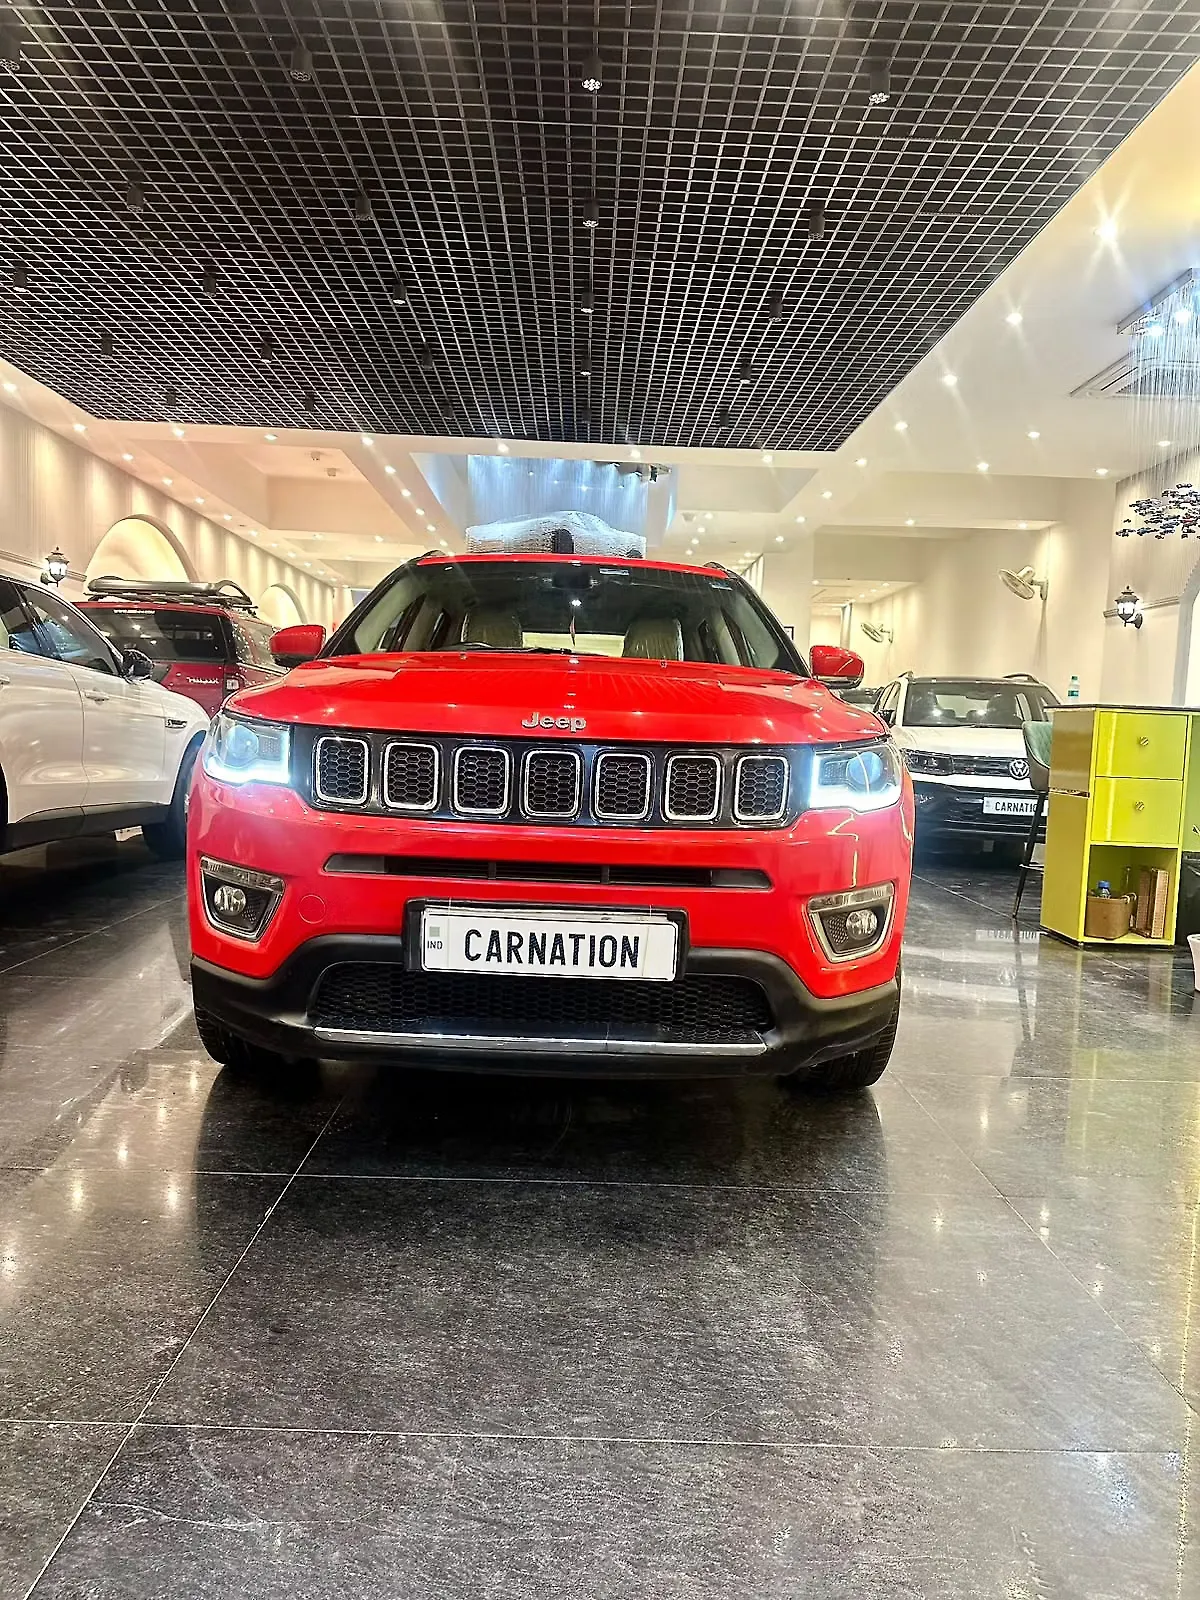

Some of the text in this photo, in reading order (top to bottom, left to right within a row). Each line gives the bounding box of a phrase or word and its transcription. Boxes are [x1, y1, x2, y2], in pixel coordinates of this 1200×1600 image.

[521, 711, 587, 733] Jeep
[995, 801, 1044, 813] CARNATIO
[427, 940, 443, 950] IND
[464, 929, 640, 968] CARNATION
